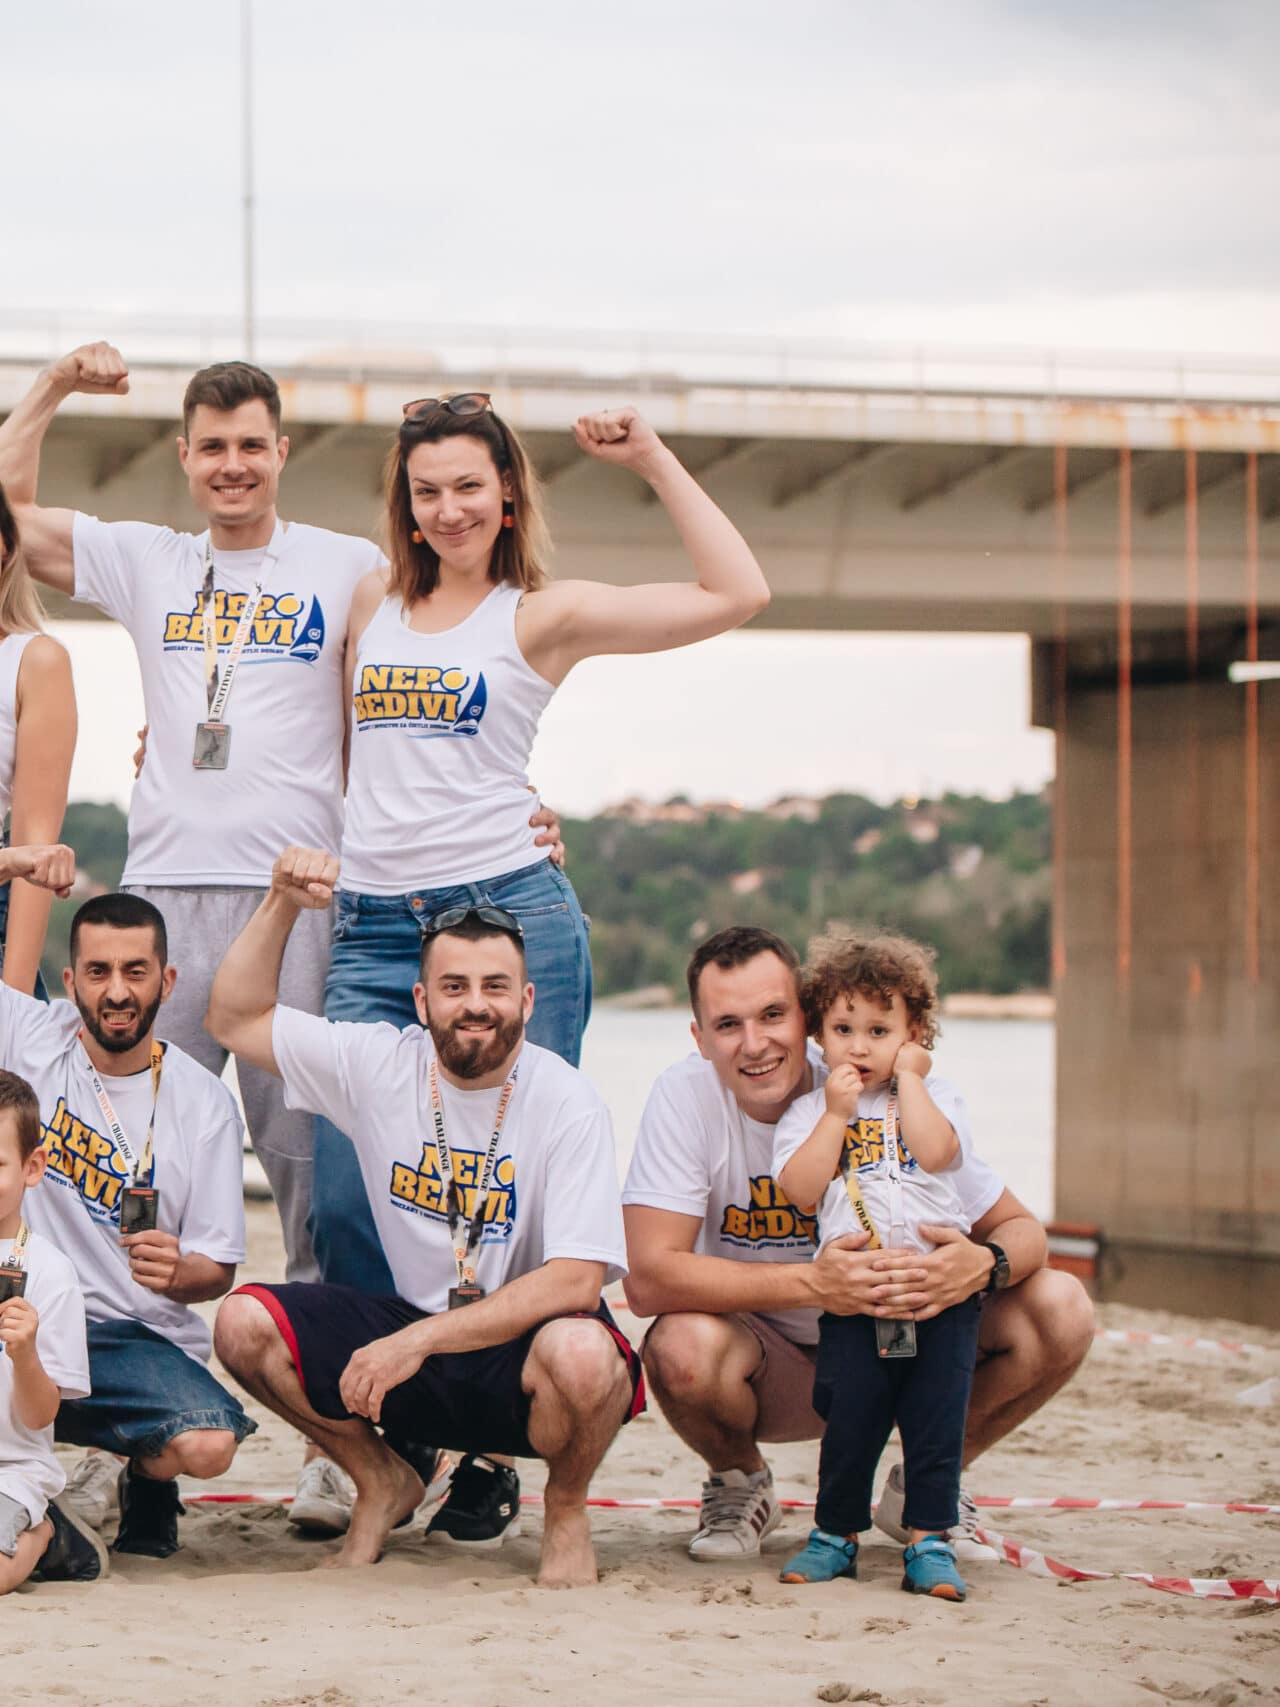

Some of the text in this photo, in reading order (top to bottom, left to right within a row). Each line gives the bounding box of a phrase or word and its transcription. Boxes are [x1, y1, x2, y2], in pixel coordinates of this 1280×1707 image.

[40, 1121, 125, 1210] EDIVI
[111, 1122, 133, 1160] CHALLENGE
[434, 1111, 451, 1173] CHALLENGE
[479, 1131, 500, 1193] CHALLENGE
